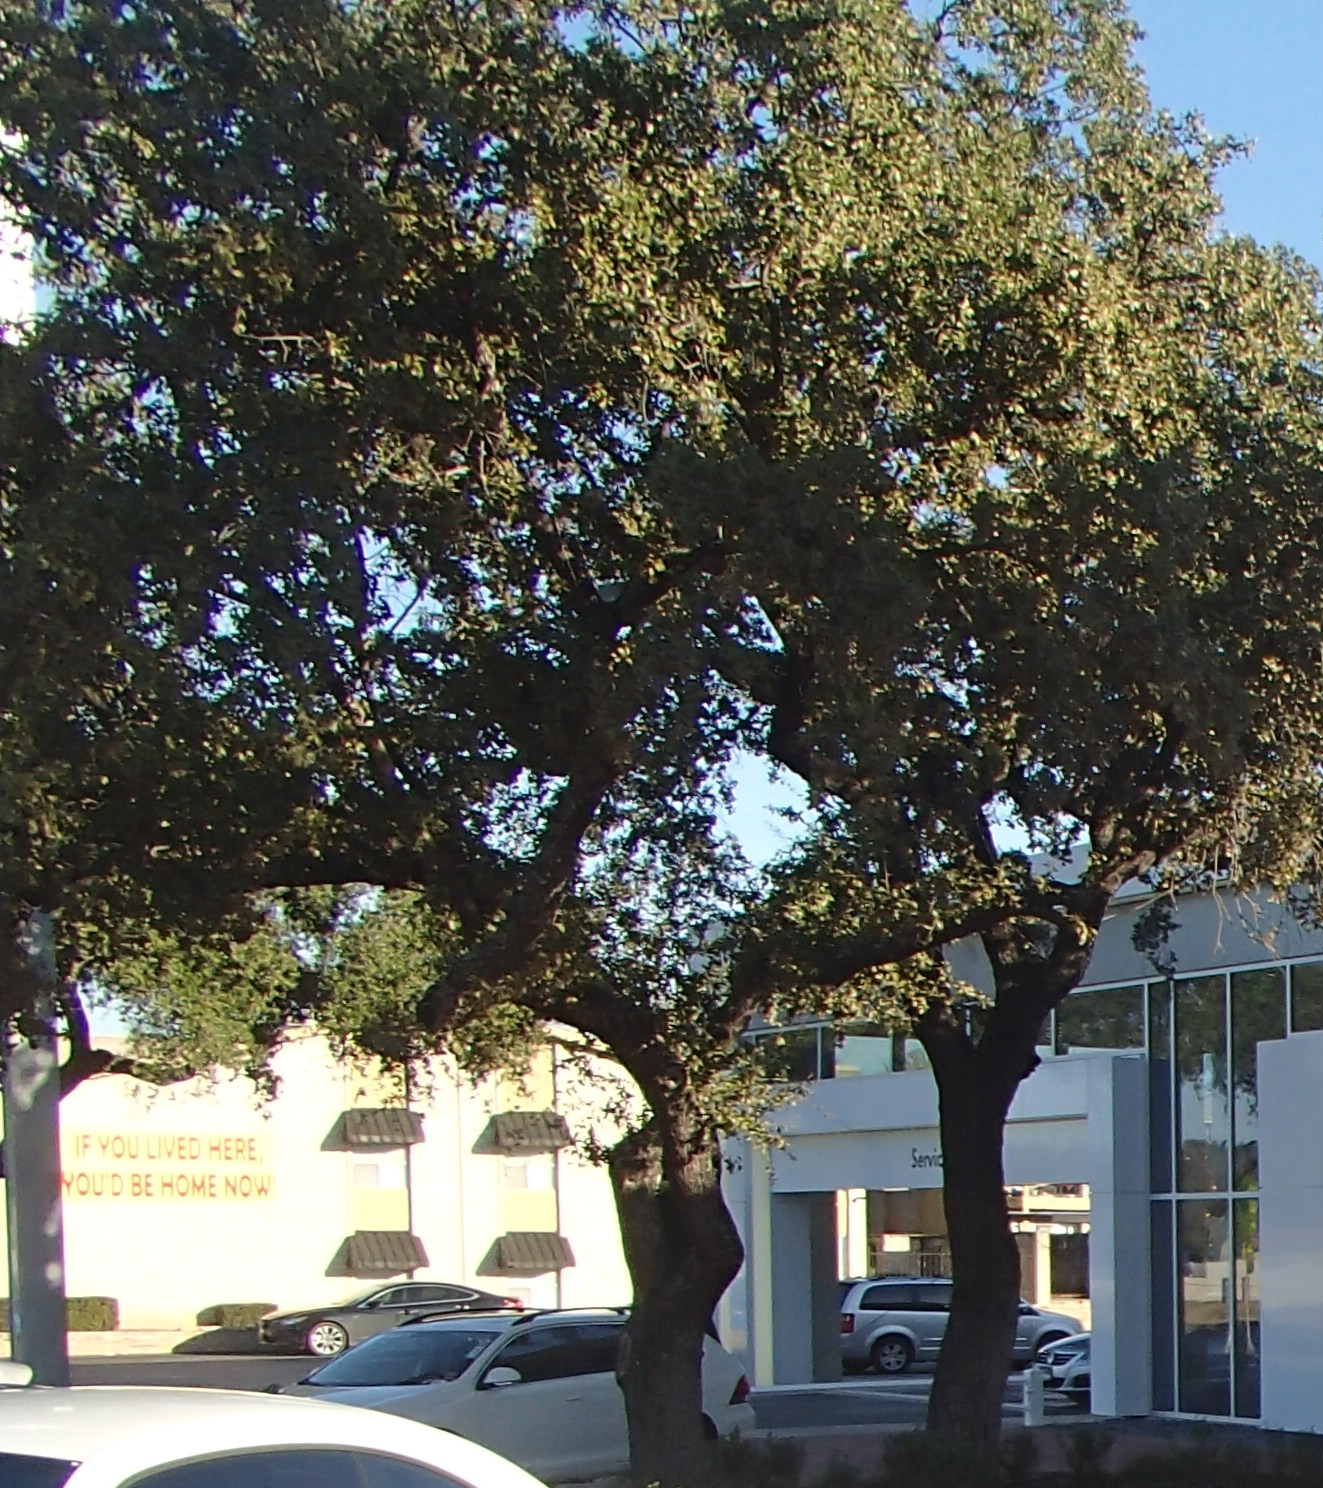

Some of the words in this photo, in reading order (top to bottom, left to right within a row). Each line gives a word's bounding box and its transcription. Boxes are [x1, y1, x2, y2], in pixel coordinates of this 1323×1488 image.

[75, 1134, 91, 1158] IF
[98, 1134, 139, 1160] YOU
[147, 1136, 201, 1160] LIVED
[911, 1147, 944, 1168] Servic
[131, 1173, 154, 1198] BE
[160, 1173, 218, 1198] HOME
